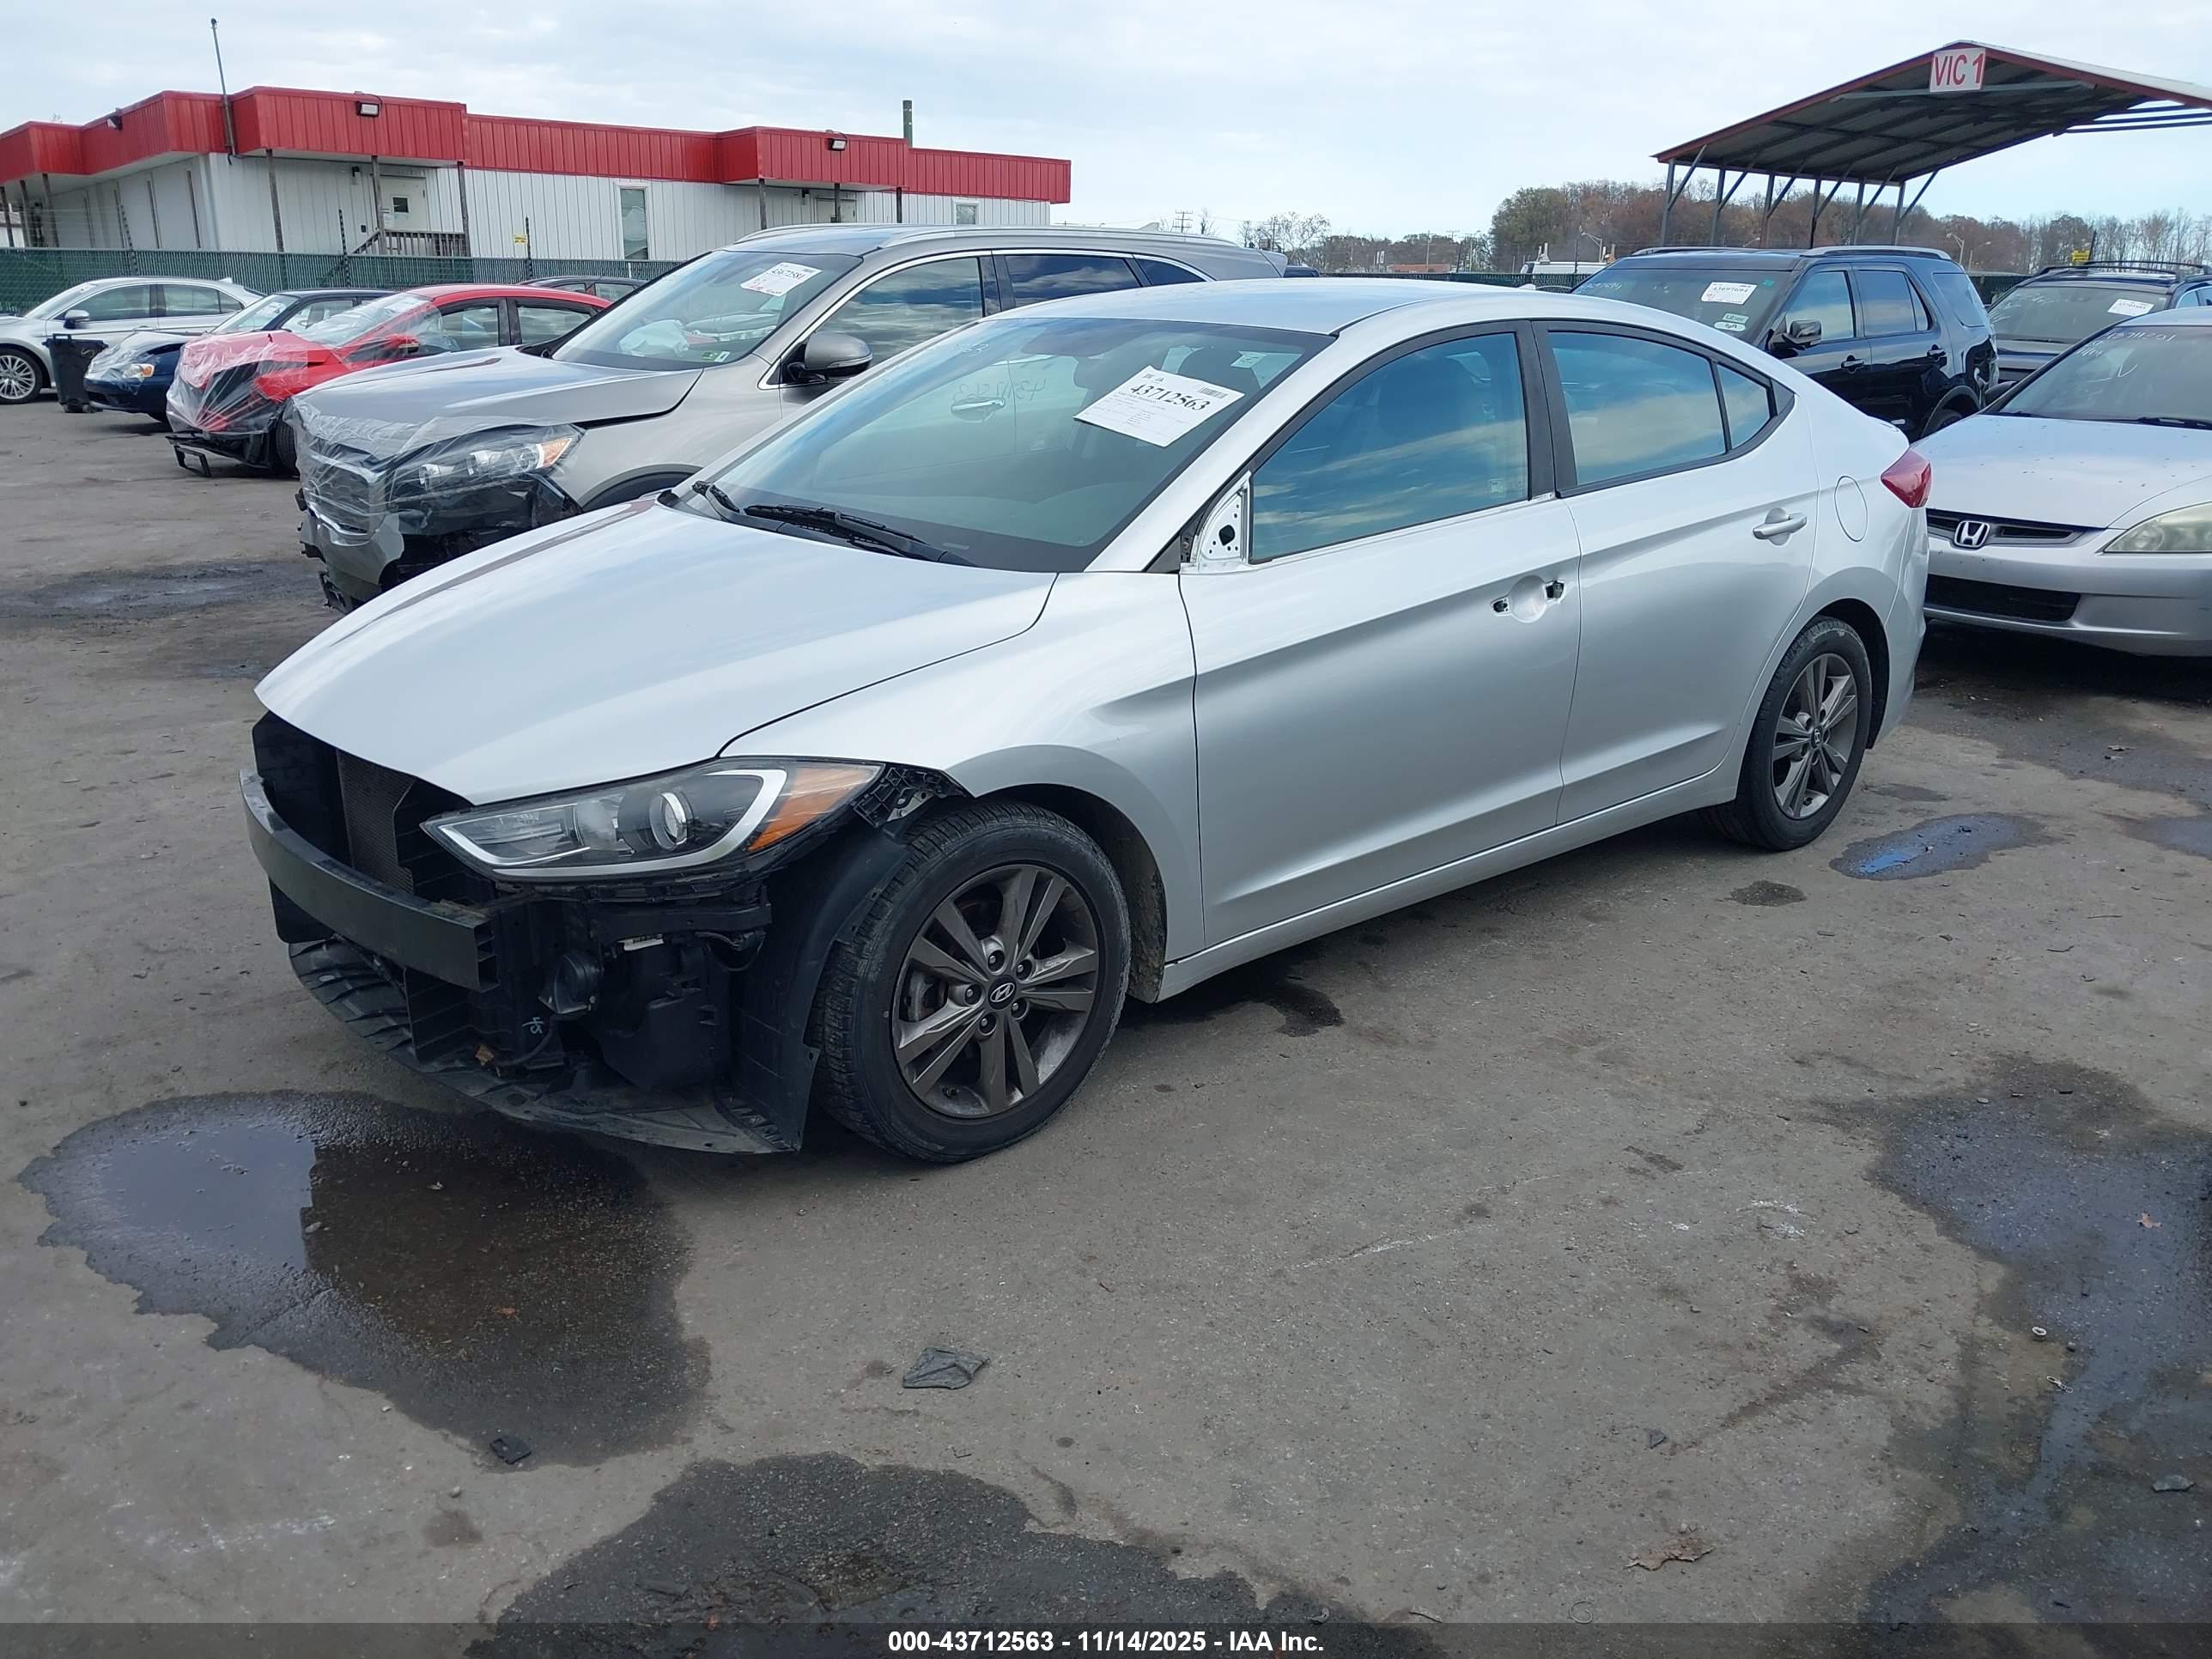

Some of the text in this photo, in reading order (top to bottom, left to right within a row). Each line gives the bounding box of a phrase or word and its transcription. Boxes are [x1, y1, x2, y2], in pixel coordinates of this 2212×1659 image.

[1935, 53, 1984, 86] VIC 1
[1131, 384, 1211, 410] 43712563
